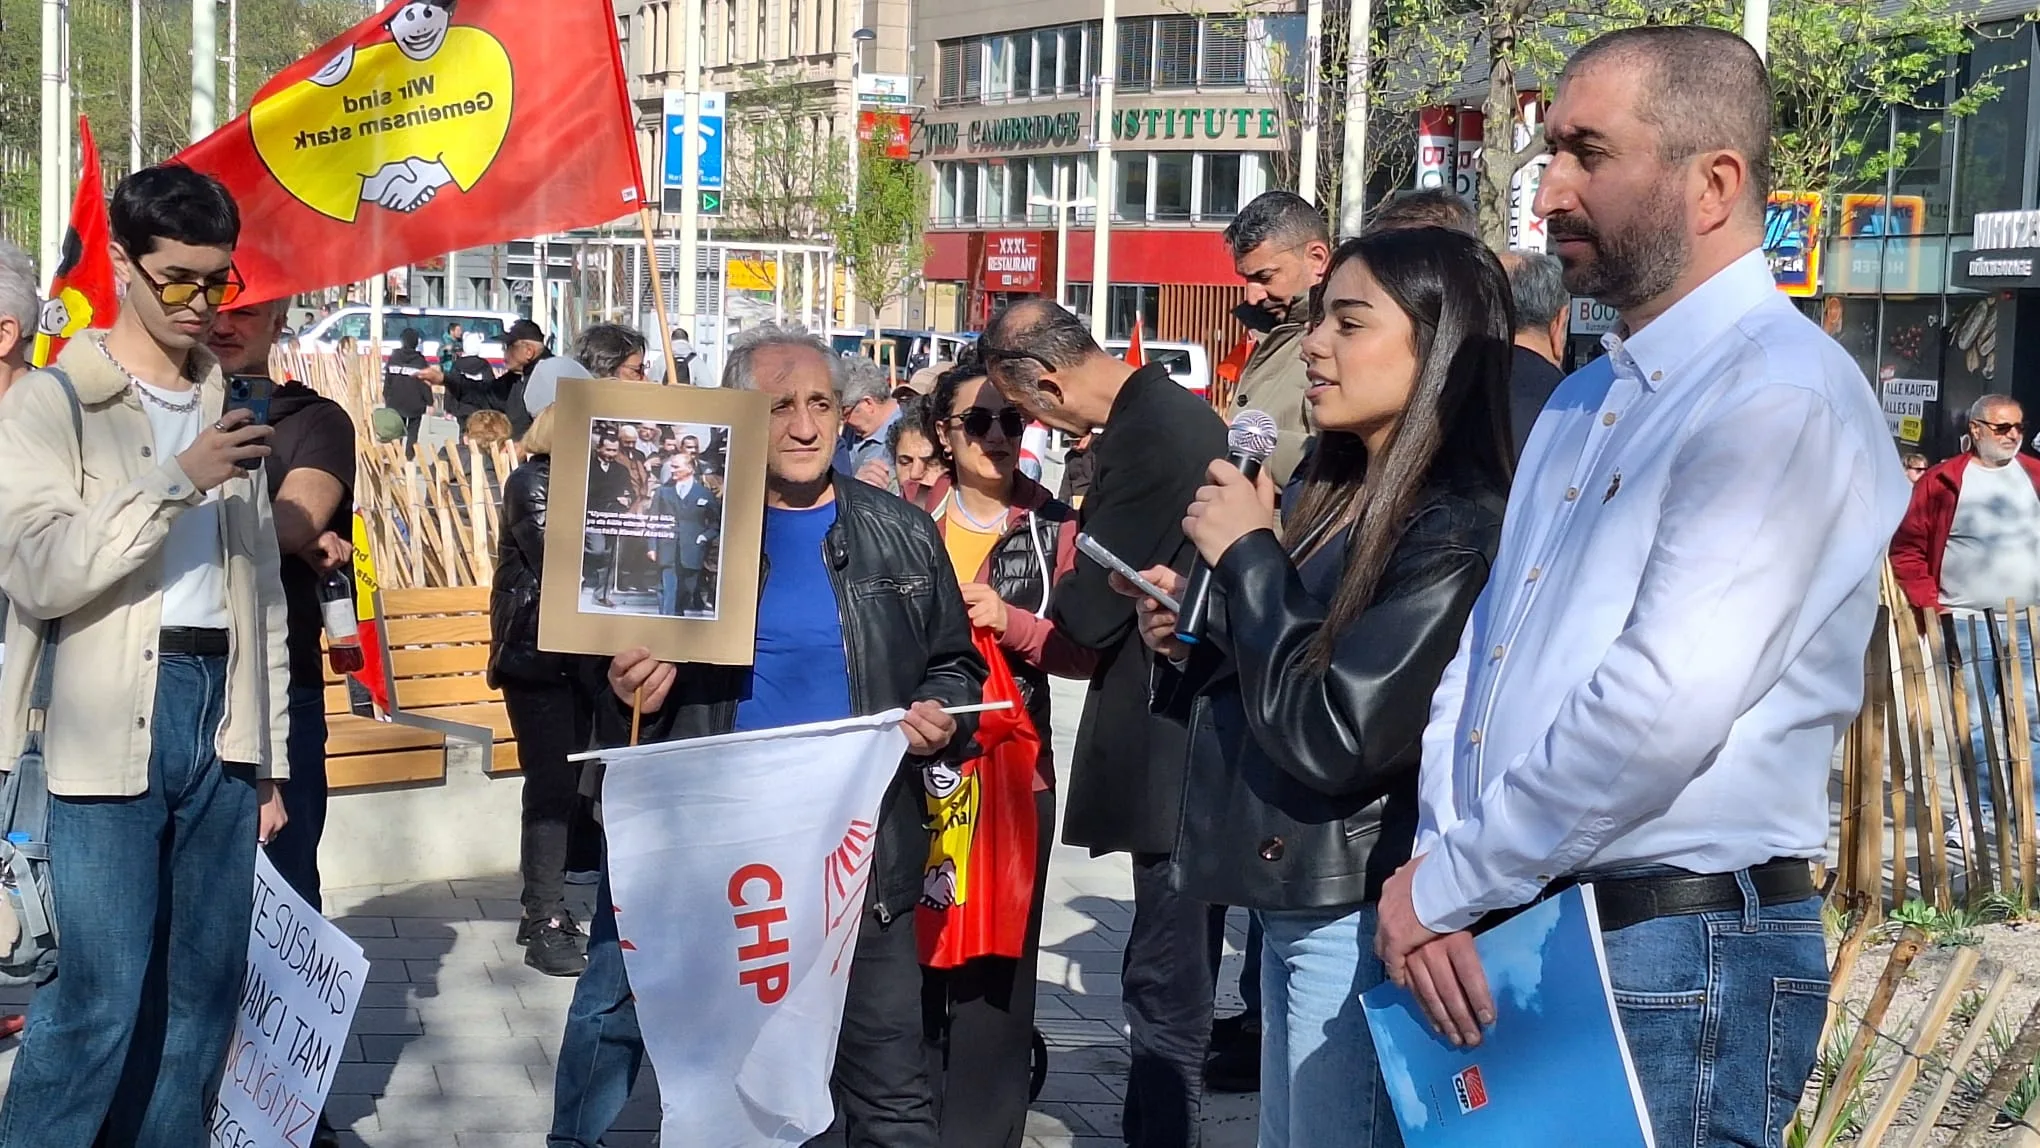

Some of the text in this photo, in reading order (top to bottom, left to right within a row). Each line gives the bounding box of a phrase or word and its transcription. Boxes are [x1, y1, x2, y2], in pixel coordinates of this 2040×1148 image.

[924, 122, 959, 147] THE
[967, 111, 1081, 146] CAMBRIDGE
[999, 237, 1027, 254] XXXL
[987, 256, 1037, 272] RESTAURANT
[1885, 382, 1936, 398] ALLE KAUFEN
[1884, 400, 1921, 416] ALLES EIN
[727, 863, 790, 1004] CHP
[268, 903, 353, 1015] SUSAMIŞ
[287, 1015, 333, 1094] TAM
[1454, 1077, 1470, 1110] CHP
